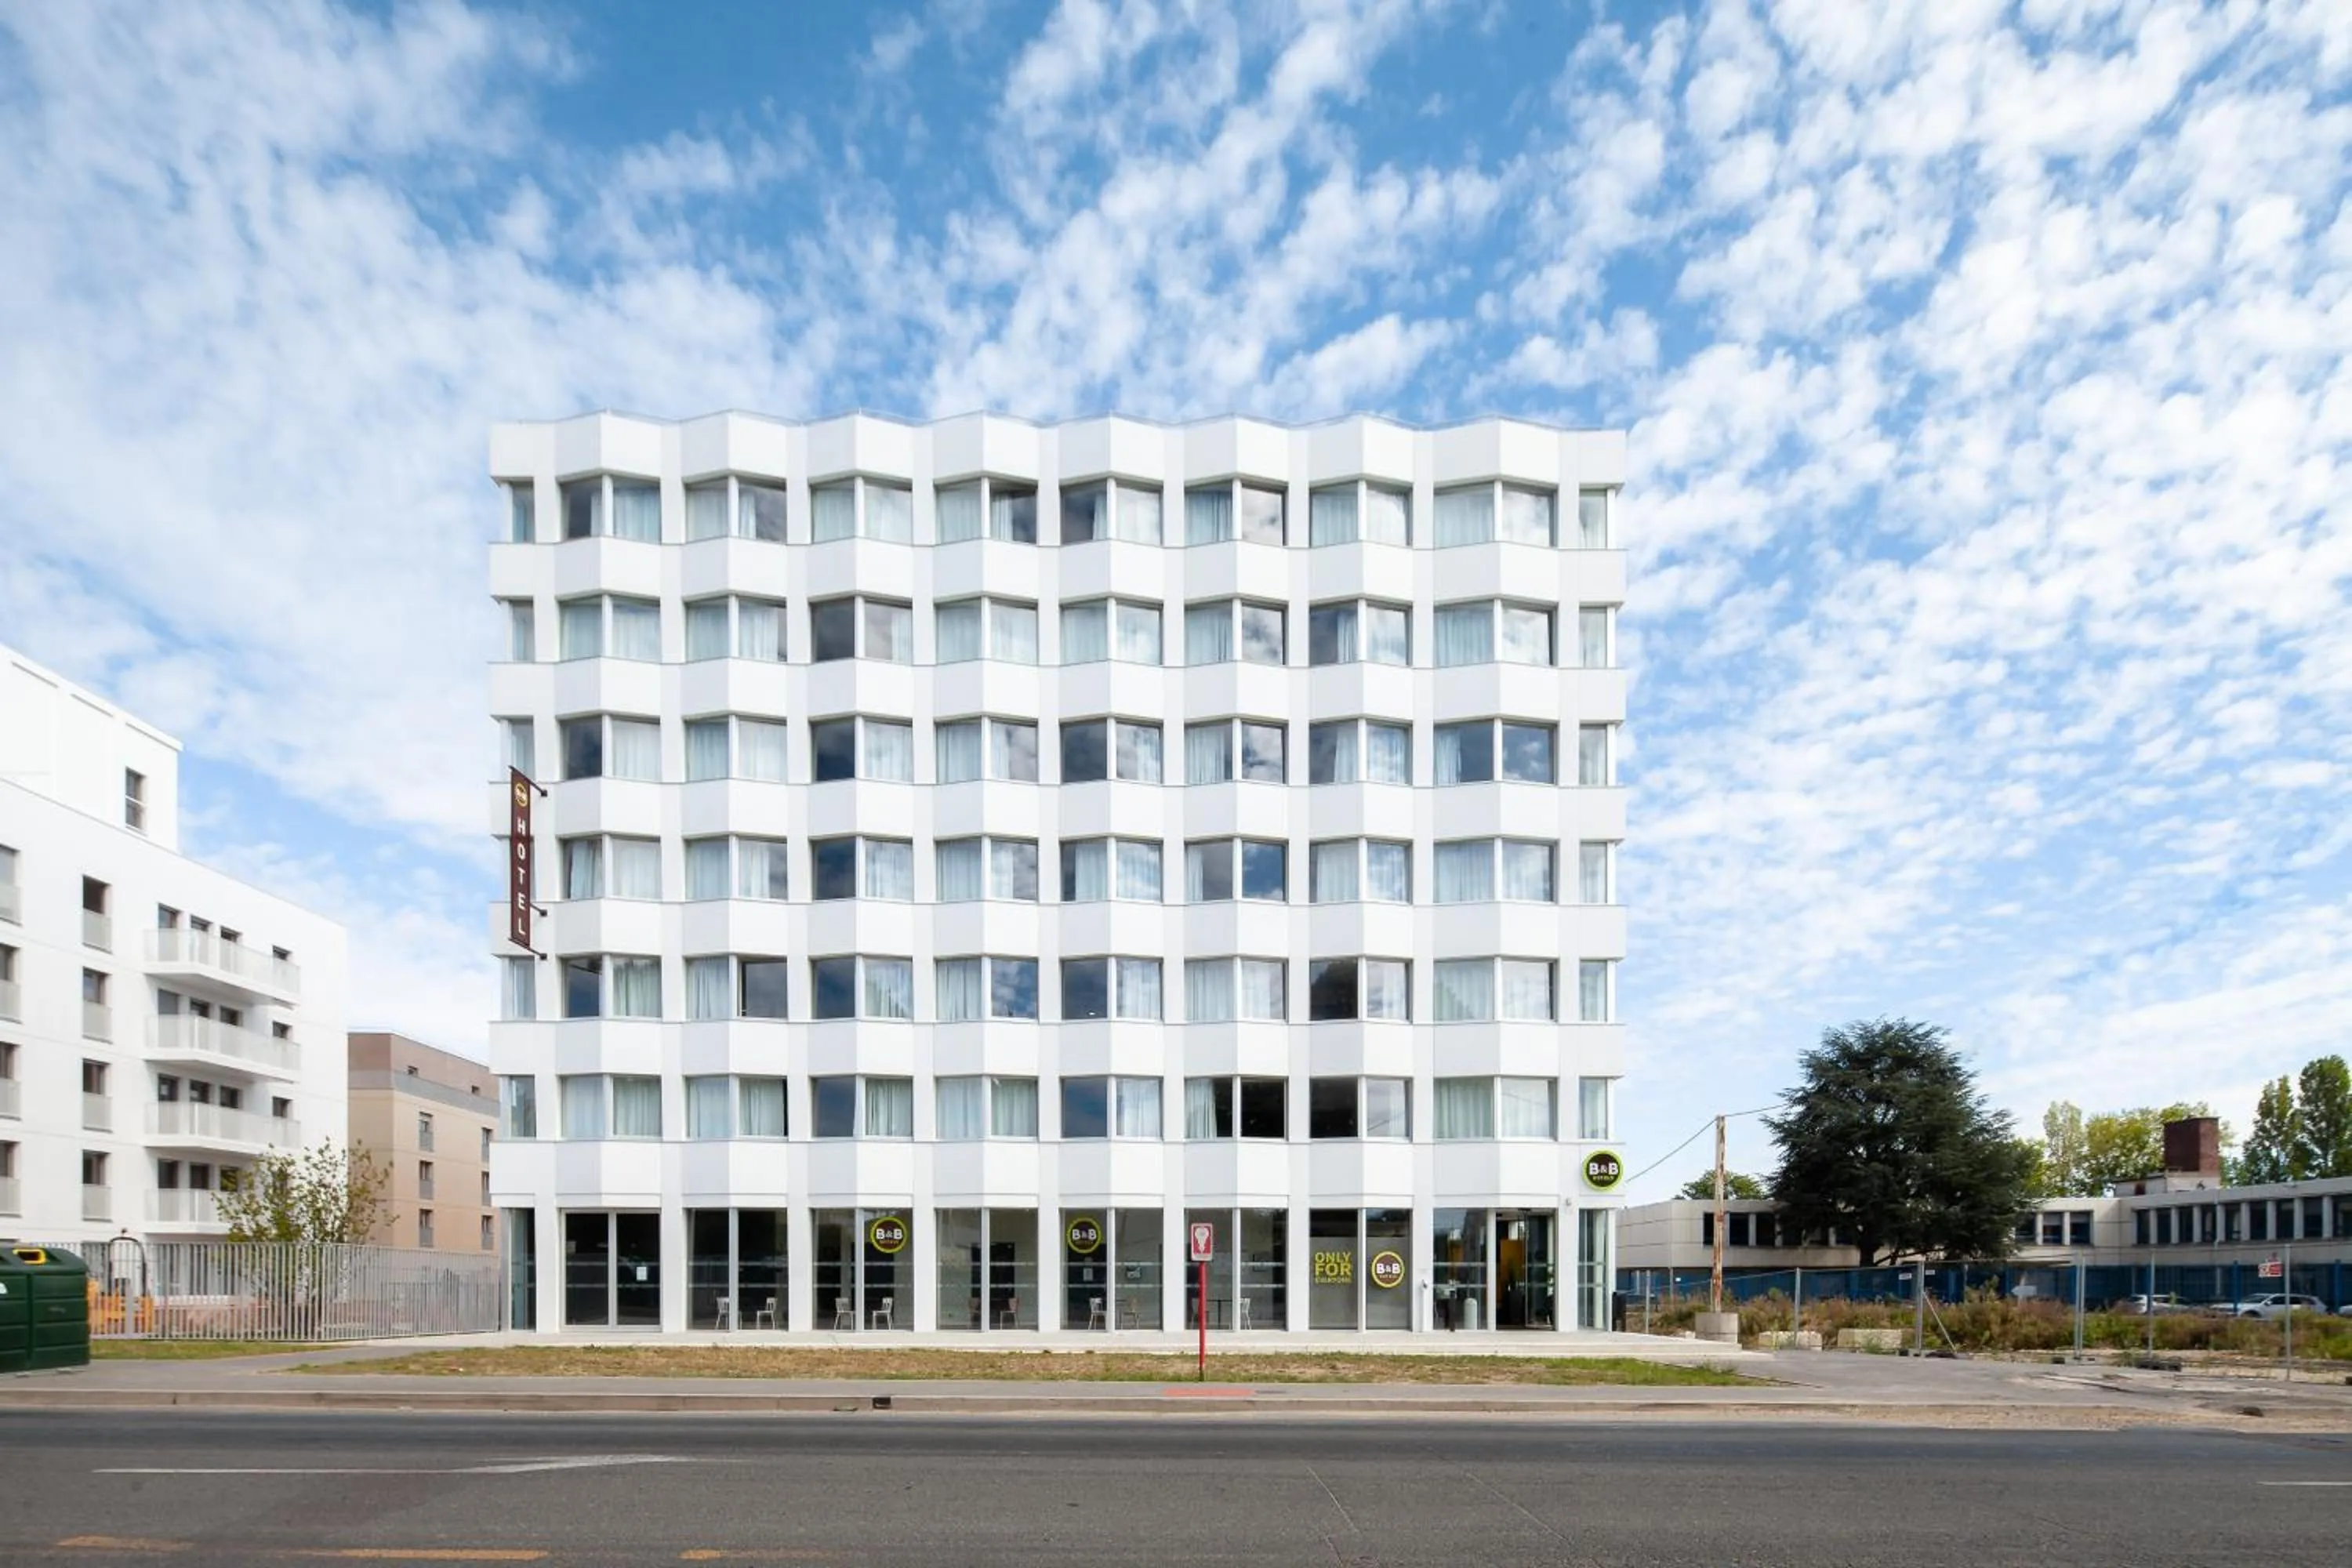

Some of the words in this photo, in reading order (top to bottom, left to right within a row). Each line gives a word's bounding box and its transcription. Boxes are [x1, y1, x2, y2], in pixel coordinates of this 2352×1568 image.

[517, 817, 526, 935] HOTEL
[1589, 1163, 1618, 1175] B&B
[876, 1229, 903, 1240] B&B
[1072, 1229, 1097, 1240] B&B
[1315, 1252, 1352, 1263] ONLY
[1315, 1263, 1352, 1276] FOR
[1376, 1263, 1401, 1274] B&B
